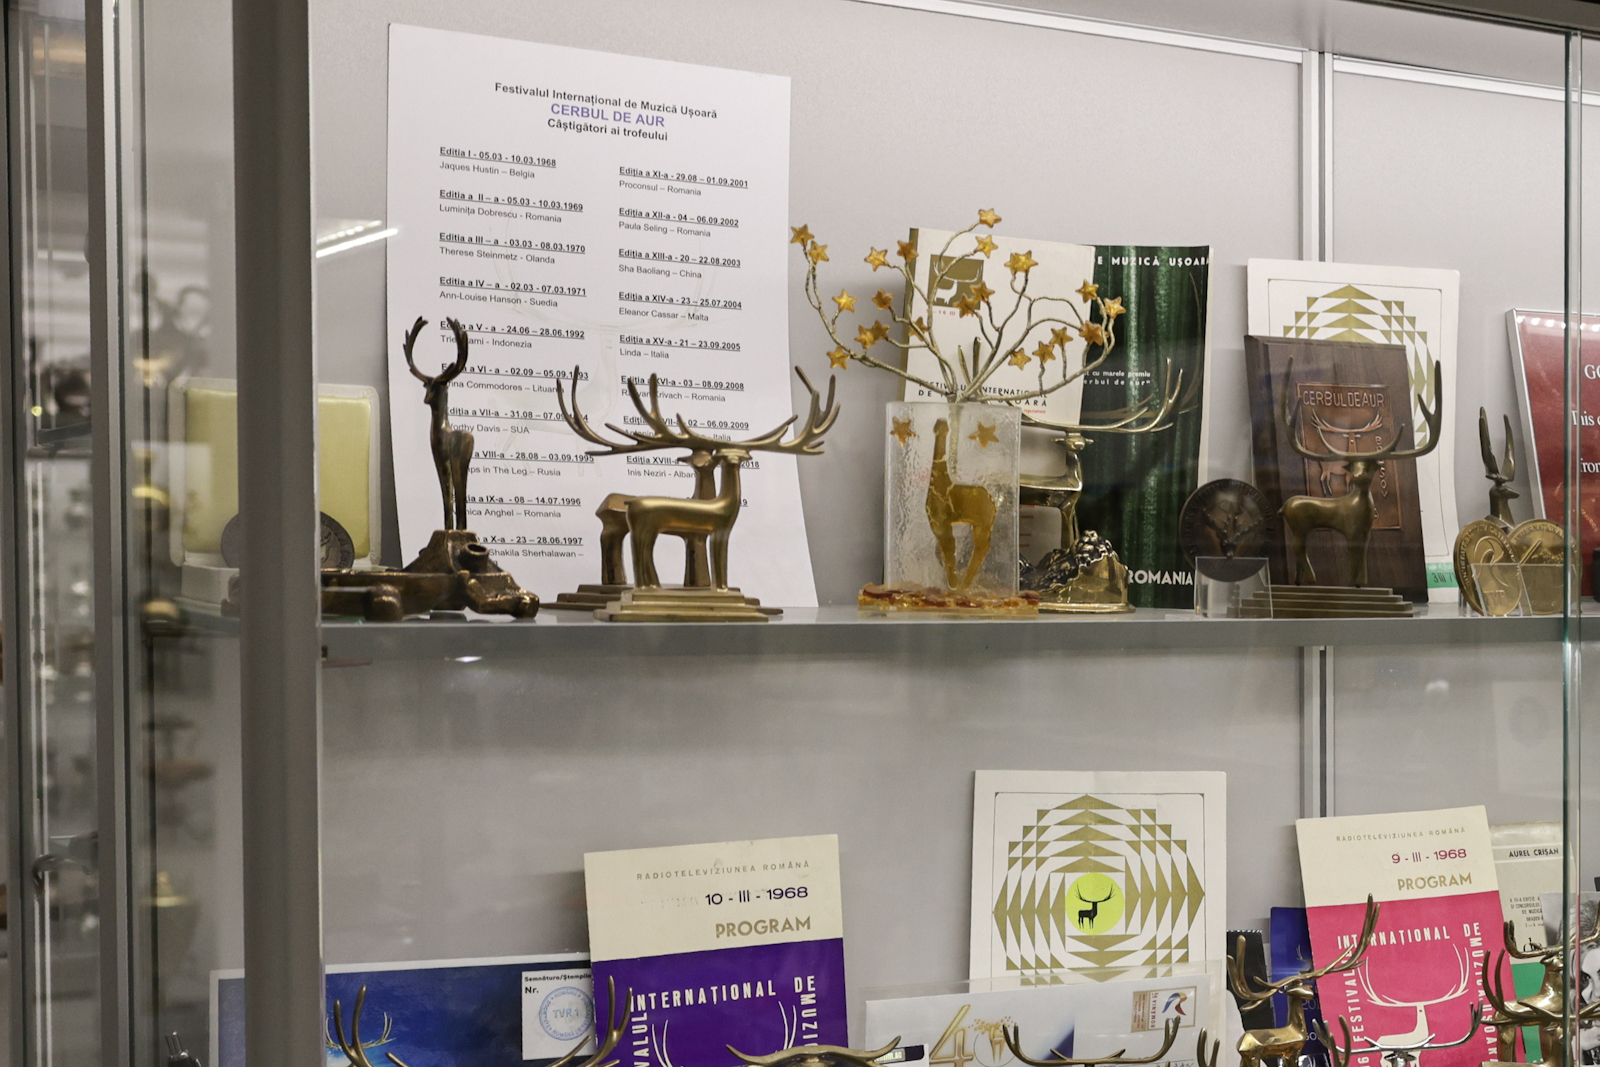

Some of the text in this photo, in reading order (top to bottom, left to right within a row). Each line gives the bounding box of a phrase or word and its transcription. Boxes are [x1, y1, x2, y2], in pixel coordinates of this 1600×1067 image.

[495, 82, 549, 98] Festivalul
[625, 99, 637, 109] de
[641, 101, 677, 114] Muzică
[551, 103, 665, 127] CERBUL DE AUR
[611, 125, 668, 141] ai trofeului
[479, 151, 502, 161] 05.03
[511, 155, 556, 167] 10.03.1968
[440, 162, 535, 179] Jaques Hustin Belgia
[619, 180, 701, 196] Proconsul Romania
[706, 176, 748, 188] 01.09.2001
[507, 197, 583, 211] 05.03 10.03.1969
[478, 207, 562, 223] Dobrescu Romania
[619, 221, 711, 237] Paula Seling Romania
[541, 242, 585, 253] 08.03.1970
[440, 247, 555, 264] Therese Steinmetz Olanda
[1112, 256, 1160, 266] MUZICĂ
[619, 265, 702, 278] Sha Baoliang China
[440, 291, 558, 307] Ann-Louise Hanson Suedia
[700, 299, 742, 309] 25.07.2004
[619, 308, 709, 322] Eleanor Cassar Malta
[540, 328, 584, 338] 28.06.1992
[492, 337, 532, 348] Indonezia
[620, 349, 669, 360] Linda Italia
[467, 380, 522, 393] Commodores
[511, 425, 530, 434] SUA
[537, 467, 561, 477] Rusia
[483, 508, 561, 518] Anghel Romania
[1128, 570, 1193, 585] ROMANIA
[1336, 831, 1424, 842] RADIOTELEVIZIUNEA
[1391, 849, 1467, 864] 9 1968
[1509, 850, 1530, 858] AUREL
[637, 865, 755, 881] RADIOTELEVIZIUNEA
[1397, 873, 1472, 891] PROGRAM
[706, 887, 808, 905] 10 1968
[715, 916, 811, 938] PROGRAM
[1464, 922, 1481, 936] DE
[525, 986, 539, 994] Nr.
[794, 975, 816, 993] DE
[552, 1009, 573, 1019] TVR
